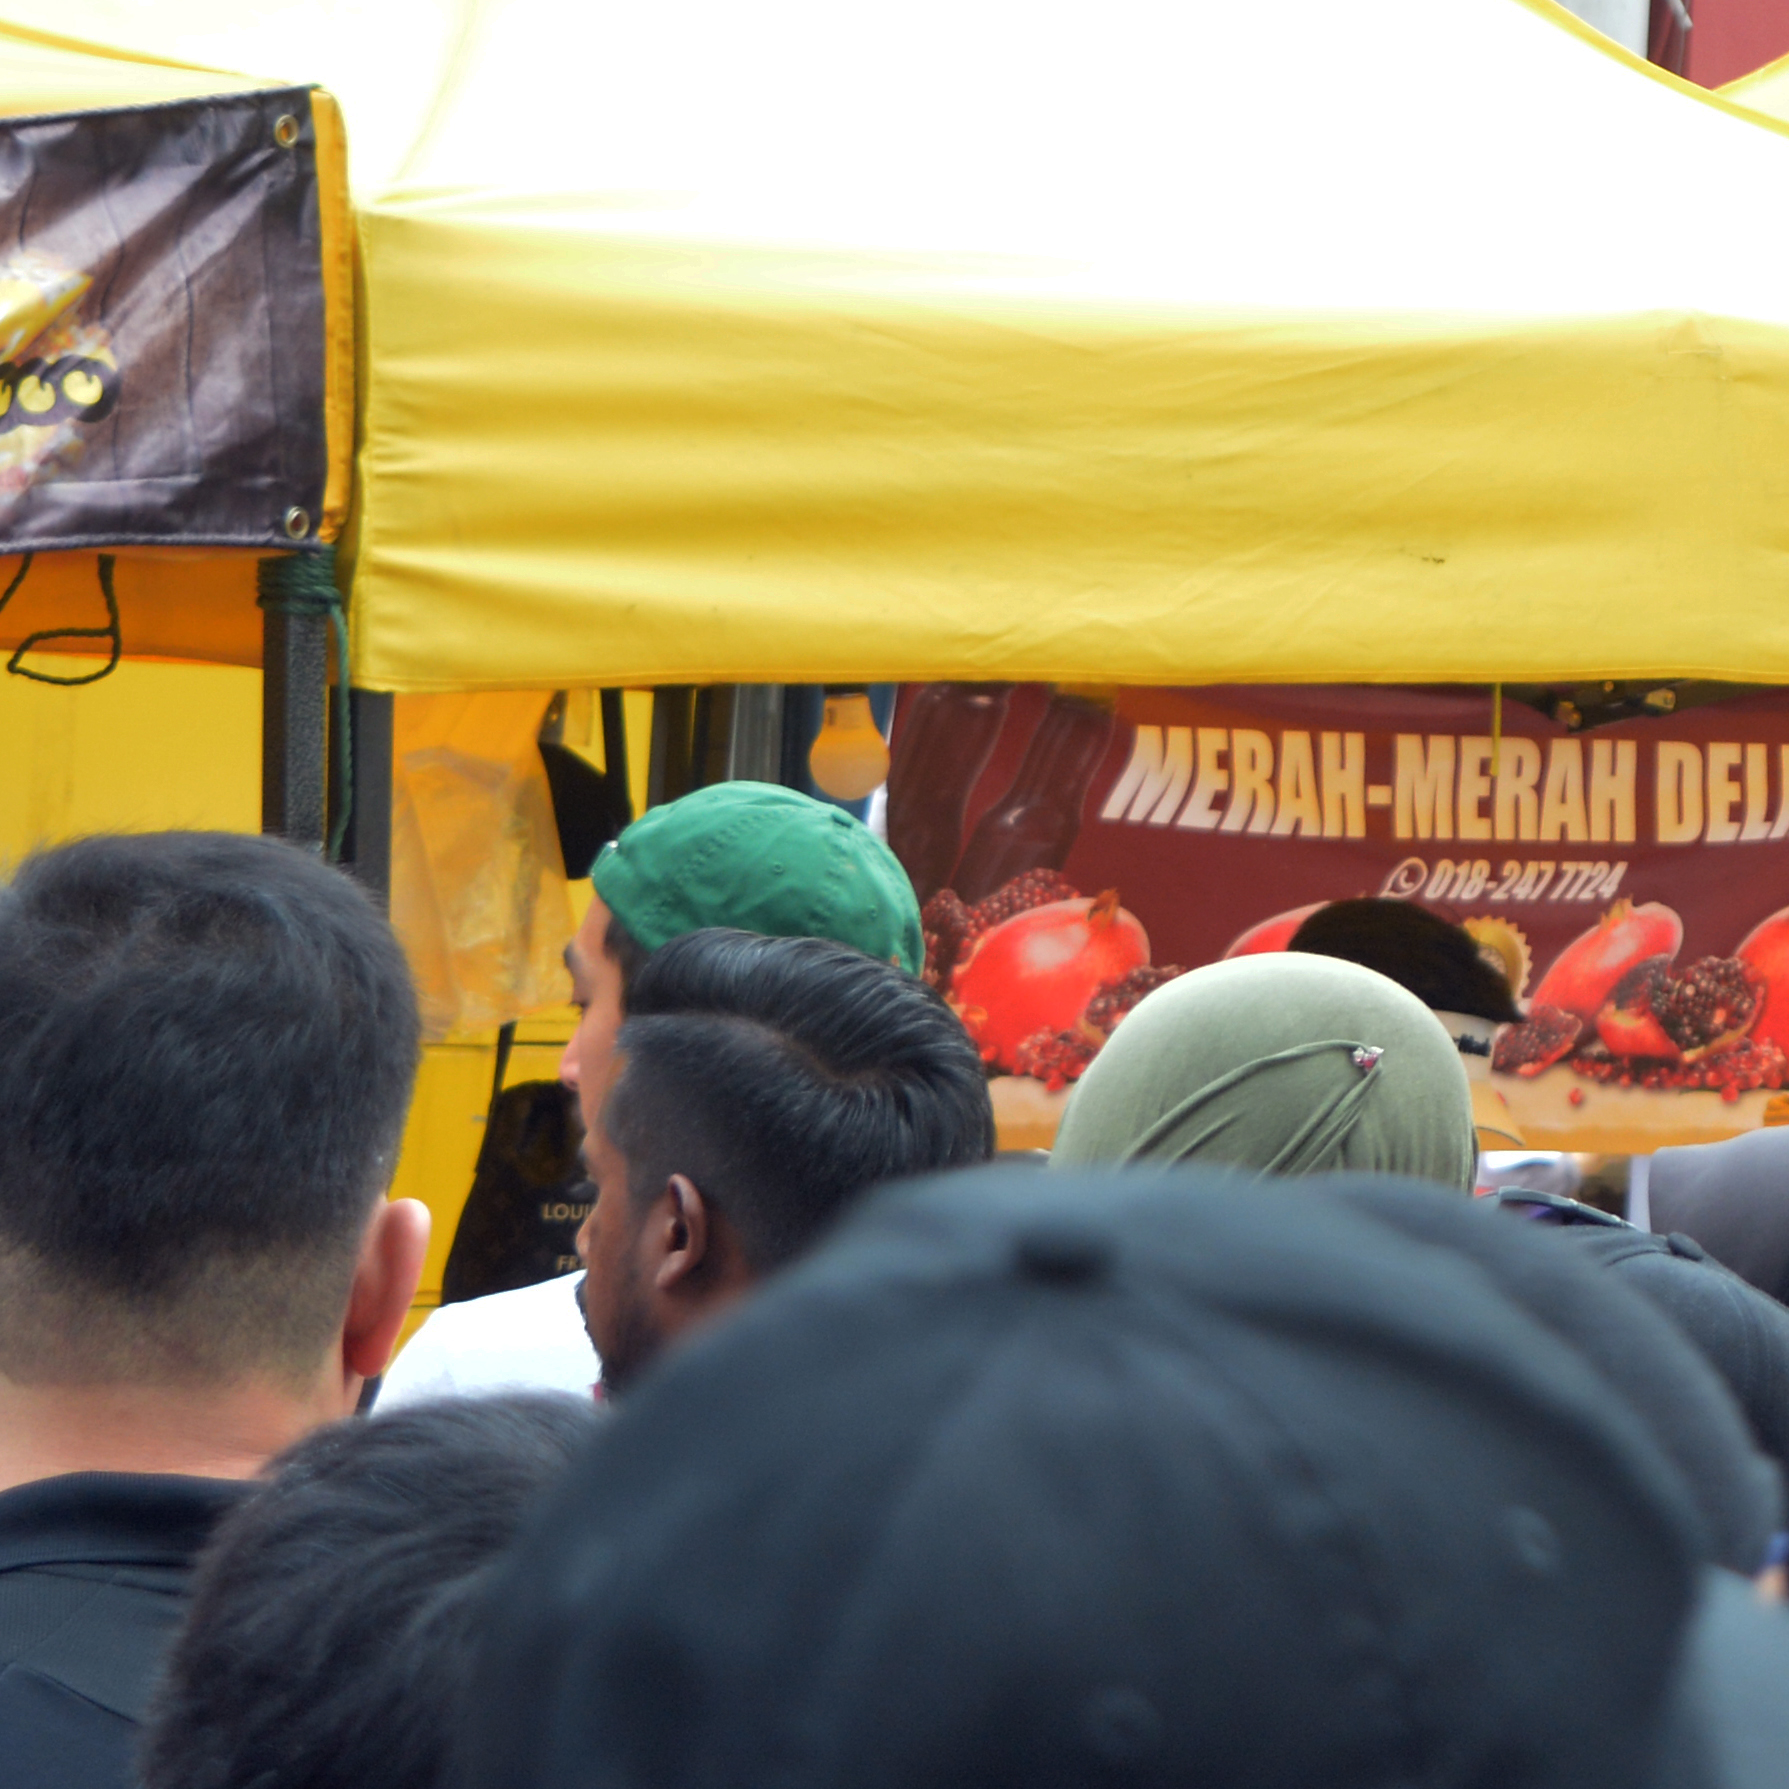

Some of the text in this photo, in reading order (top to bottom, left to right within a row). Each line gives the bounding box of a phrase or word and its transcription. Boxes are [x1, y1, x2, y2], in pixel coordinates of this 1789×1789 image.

[1100, 724, 1638, 844] MERAH-MERAH
[1423, 858, 1557, 901] 018-247
[541, 1203, 592, 1220] LOUI
